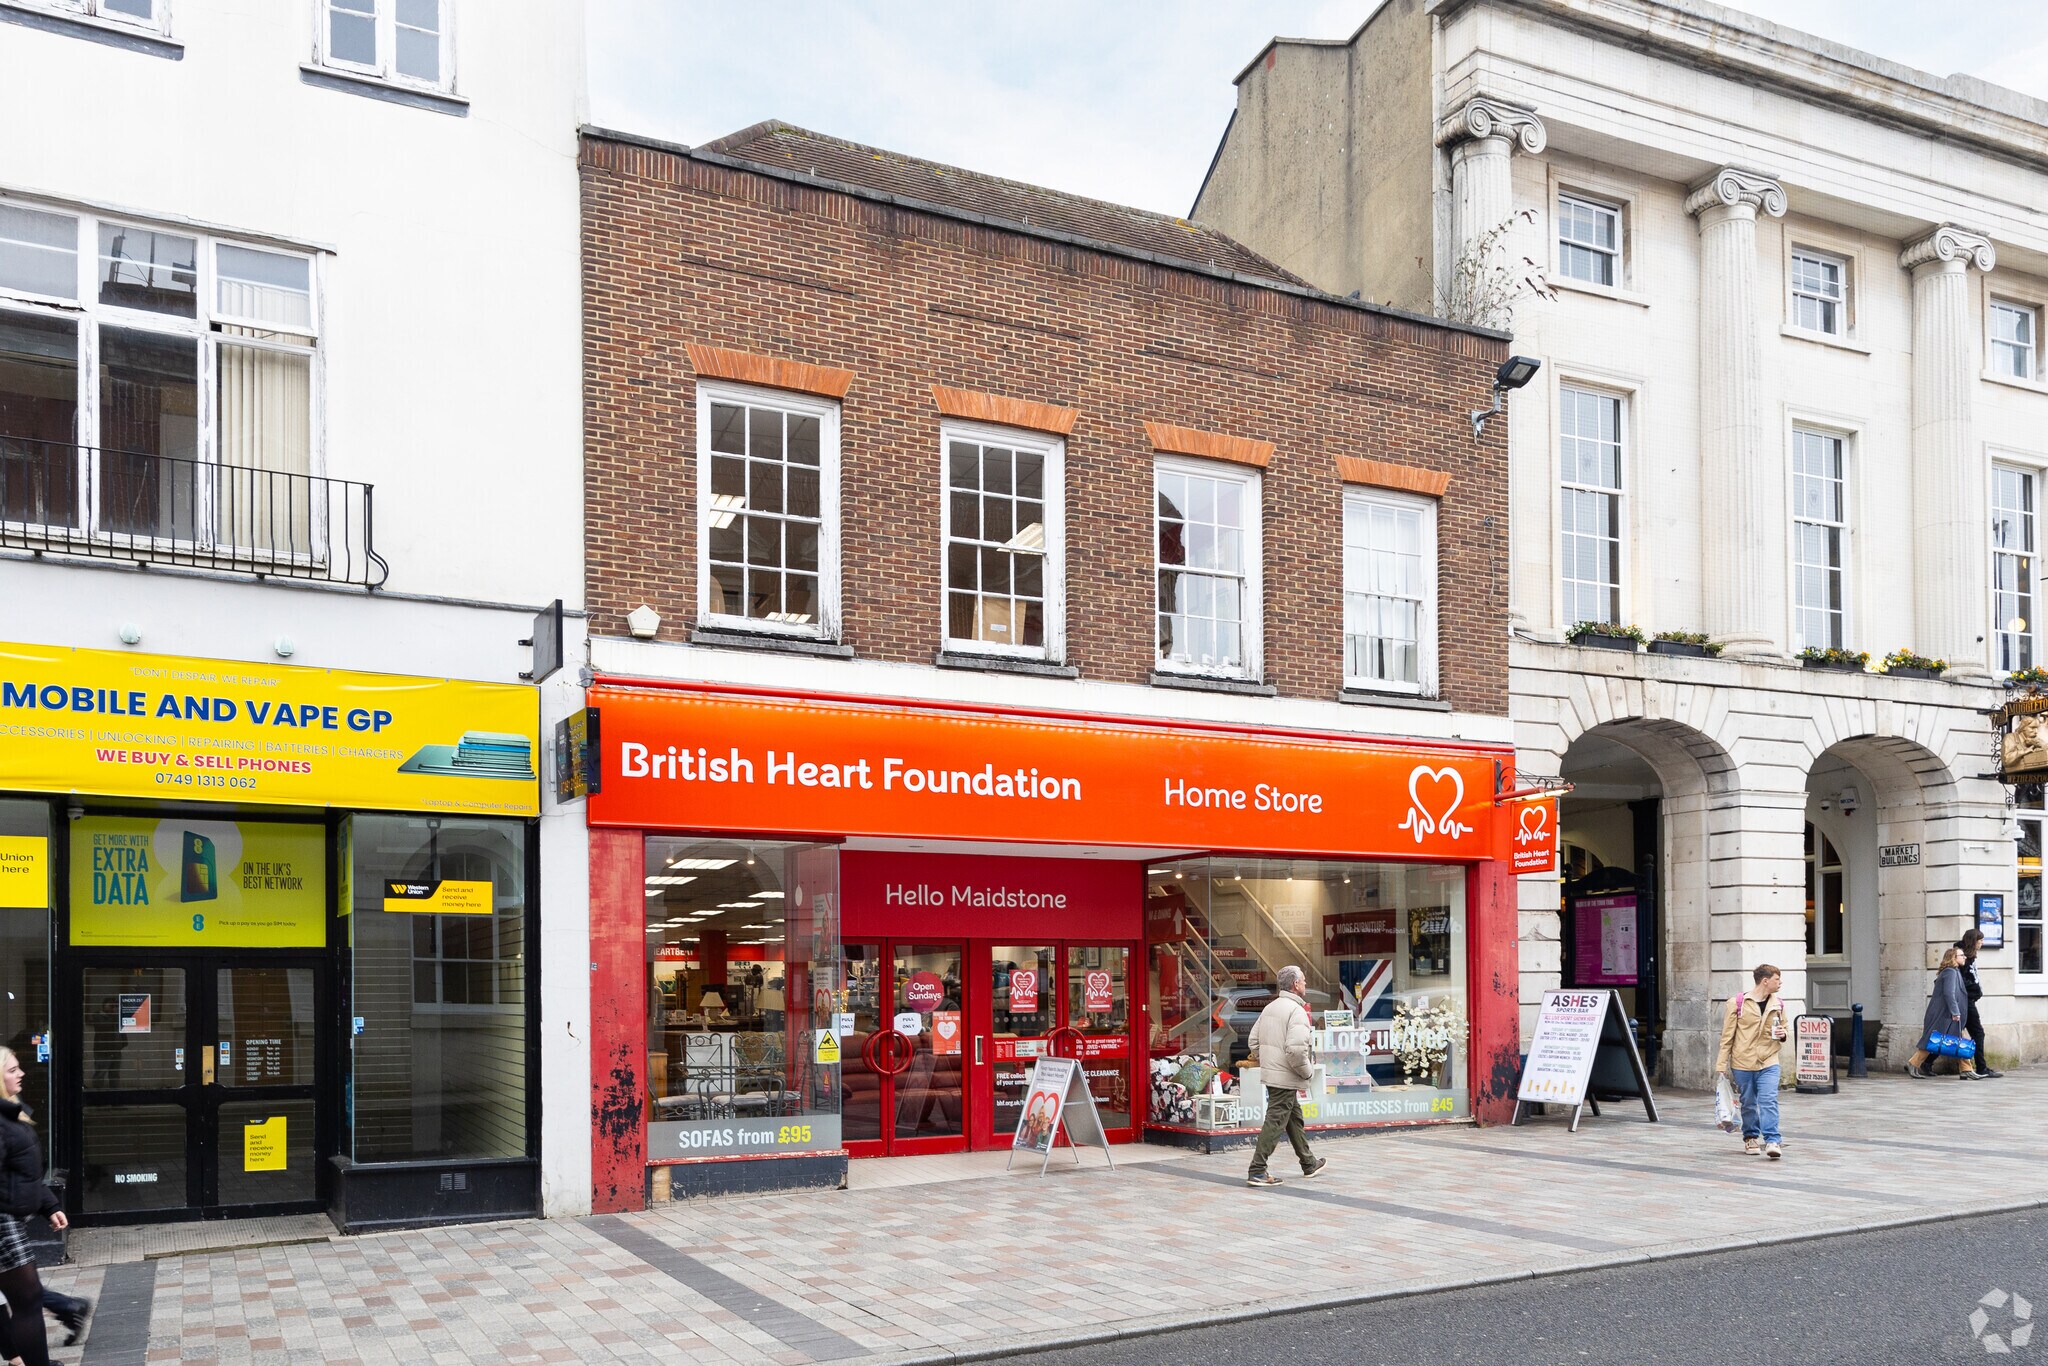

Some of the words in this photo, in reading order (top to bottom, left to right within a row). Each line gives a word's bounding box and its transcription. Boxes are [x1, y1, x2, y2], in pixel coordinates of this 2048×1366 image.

[171, 670, 219, 684] DESPAIR,
[221, 675, 238, 684] WE
[2, 681, 147, 716] MOBILE
[155, 694, 238, 722] AND
[245, 699, 339, 730] VAPE
[347, 708, 393, 733] GP
[2009, 699, 2048, 714] MUGGLETO
[0, 724, 85, 740] CCESSORIES
[97, 731, 177, 746] UNLOCKING
[188, 737, 255, 751] REPAIRING
[266, 741, 328, 756] BATTERIES
[339, 747, 404, 760] CHARGERS
[96, 748, 127, 763] WE
[131, 751, 171, 765] BUY
[175, 754, 189, 767] &
[194, 755, 234, 769] SELL
[238, 757, 312, 774] PHONES
[620, 741, 754, 785] British
[766, 750, 873, 790] Heart
[882, 757, 1082, 801] Foundation
[155, 772, 193, 785] 0749
[197, 775, 225, 787] 1313
[229, 776, 257, 789] 062
[1165, 777, 1246, 811] Home
[1254, 783, 1323, 814] Store
[454, 799, 461, 807] &
[462, 800, 503, 809] Computer
[503, 802, 533, 811] Repairs
[93, 833, 107, 846] GET
[108, 834, 128, 847] MORE
[129, 835, 149, 847] WITH
[0, 853, 34, 862] Union
[1513, 851, 1533, 860] British
[1532, 849, 1550, 858] Heart
[1884, 846, 1914, 857] MARKET
[93, 846, 149, 873] EXTRA
[1514, 858, 1548, 868] Foundation
[1881, 854, 1918, 865] BUILDINGS
[2, 865, 30, 874] here
[243, 861, 254, 875] ON
[256, 862, 271, 876] THE
[272, 862, 292, 877] UK'S
[93, 871, 149, 906] DATA
[243, 876, 263, 889] BEST
[264, 877, 304, 890] NETWORK
[885, 882, 944, 907] Hello
[951, 885, 1067, 909] Maidstone
[912, 982, 935, 992] Open
[908, 991, 942, 1001] Sundays
[1550, 994, 1599, 1008] ASHES
[1800, 1021, 1828, 1034] SIM3
[1090, 1069, 1120, 1077] CLEARANCE
[1229, 1104, 1261, 1121] BEDS
[1301, 1103, 1319, 1118] 65
[1326, 1099, 1402, 1118] MATTRESSES
[1404, 1101, 1429, 1113] from
[1430, 1097, 1454, 1113] £45
[678, 1127, 734, 1150] SOFAS
[737, 1128, 775, 1147] from
[777, 1124, 813, 1145] £95
[114, 1174, 126, 1184] NO
[126, 1172, 158, 1183] SMOKING
